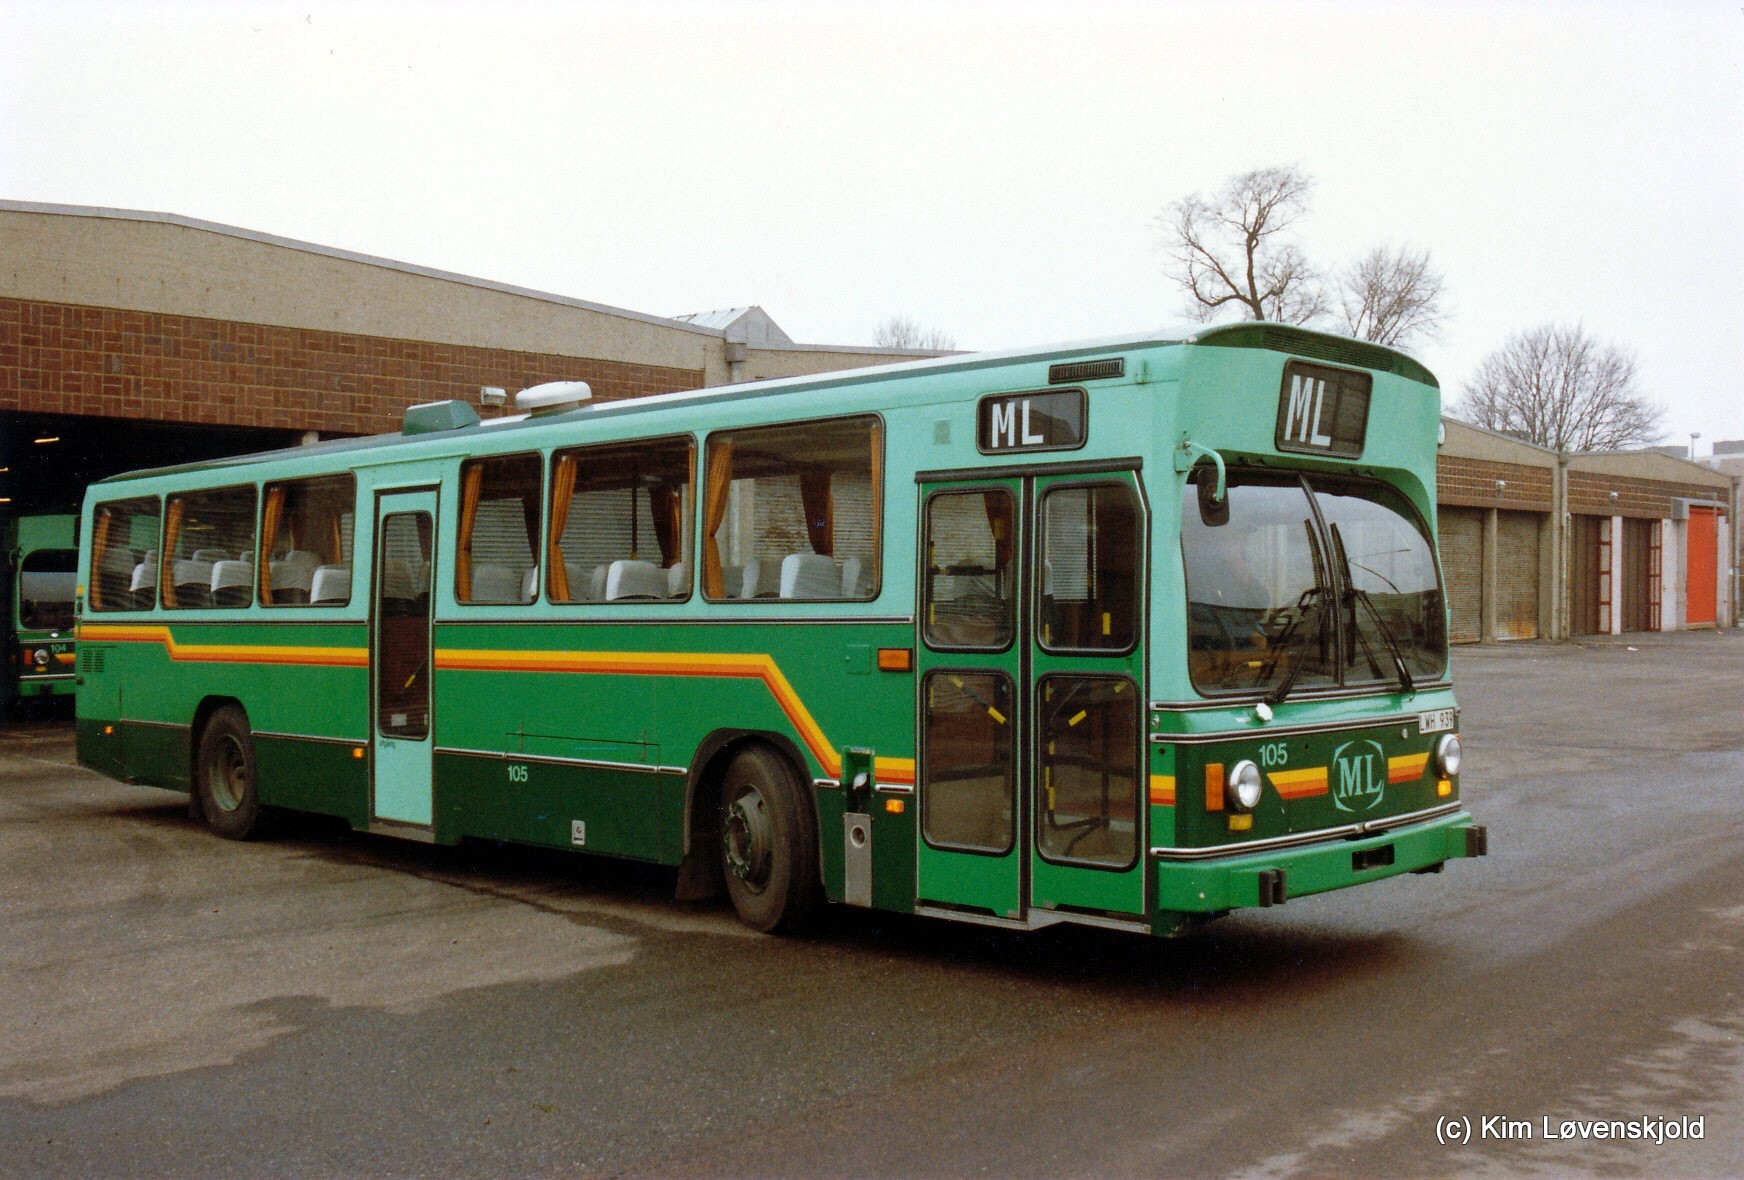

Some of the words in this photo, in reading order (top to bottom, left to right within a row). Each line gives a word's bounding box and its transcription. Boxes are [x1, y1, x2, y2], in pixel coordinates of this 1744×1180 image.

[991, 400, 1044, 448] ML
[1284, 374, 1332, 447] ML
[508, 765, 529, 782] 105
[1259, 743, 1288, 767] 105
[1337, 753, 1384, 799] ML
